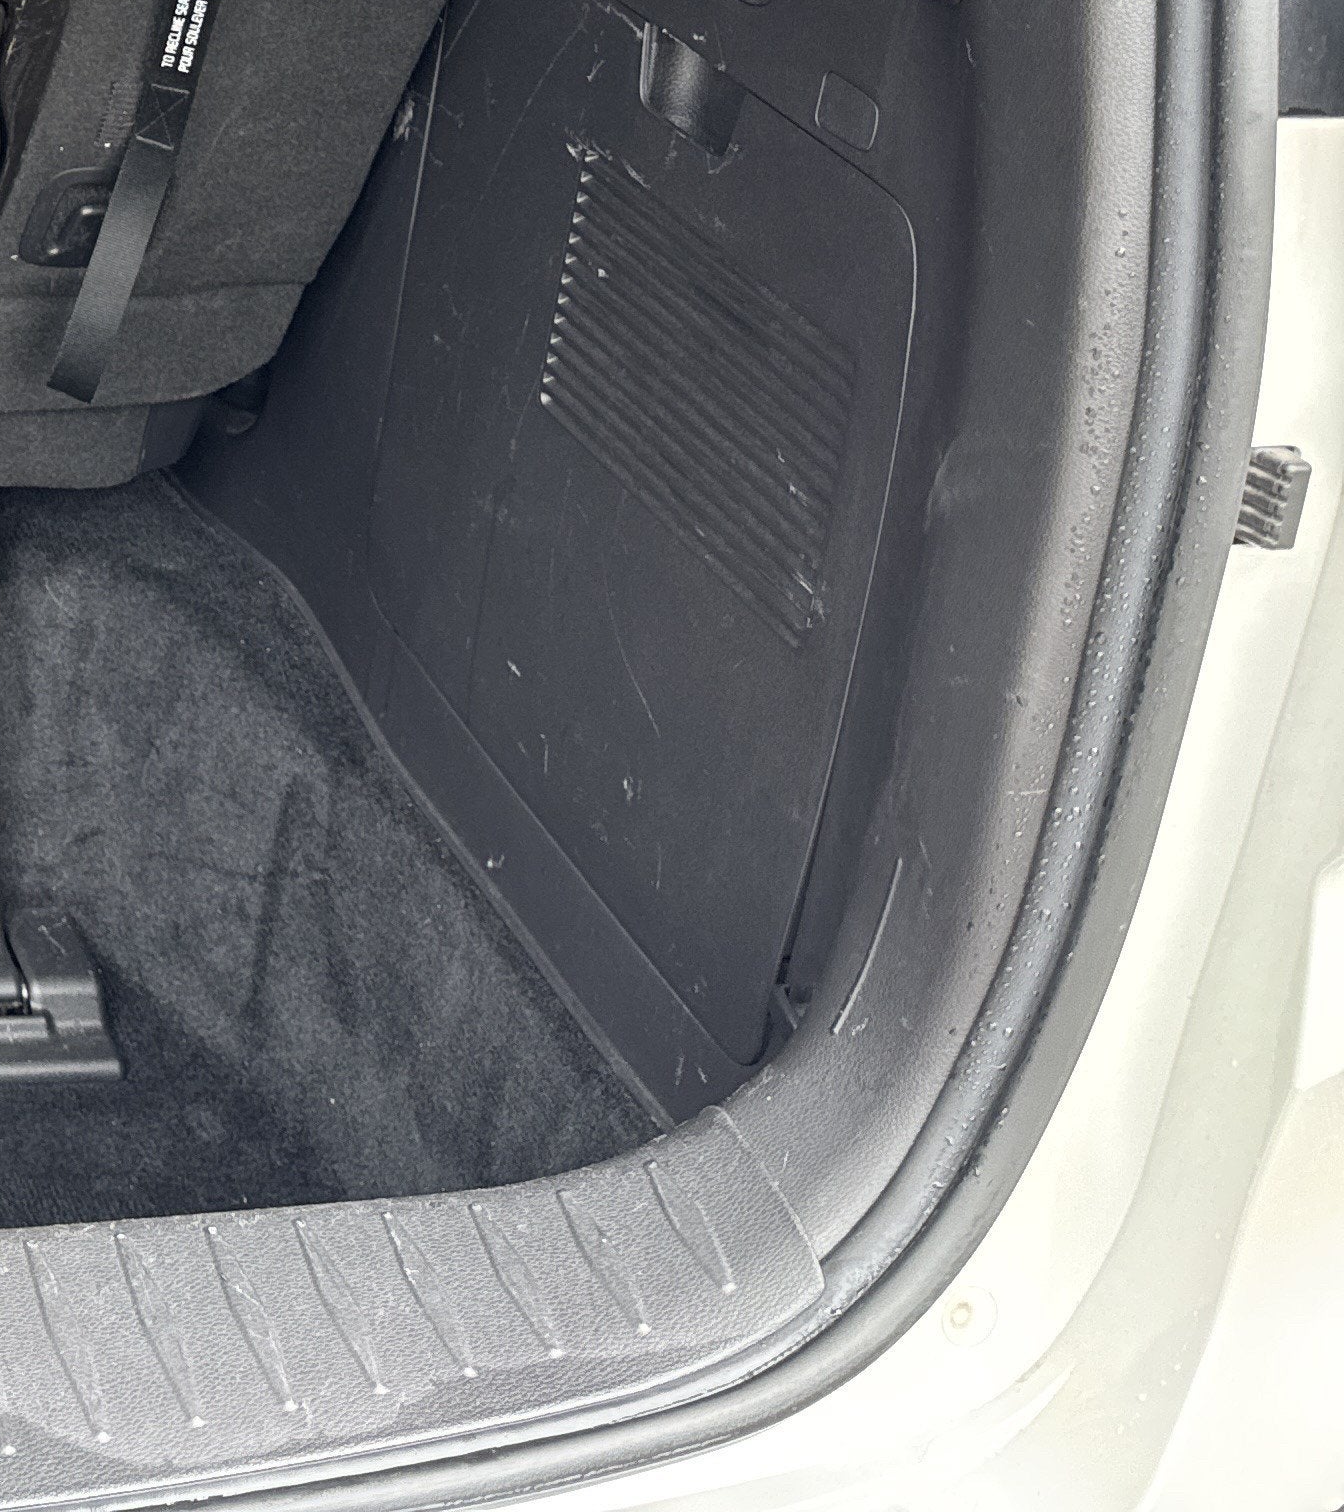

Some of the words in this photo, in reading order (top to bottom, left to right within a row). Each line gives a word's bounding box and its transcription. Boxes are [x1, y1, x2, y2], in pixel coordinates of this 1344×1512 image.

[165, 16, 185, 54] RECLINE
[185, 0, 208, 45] SOULEVER
[161, 54, 175, 67] TO
[178, 46, 195, 73] POUR
